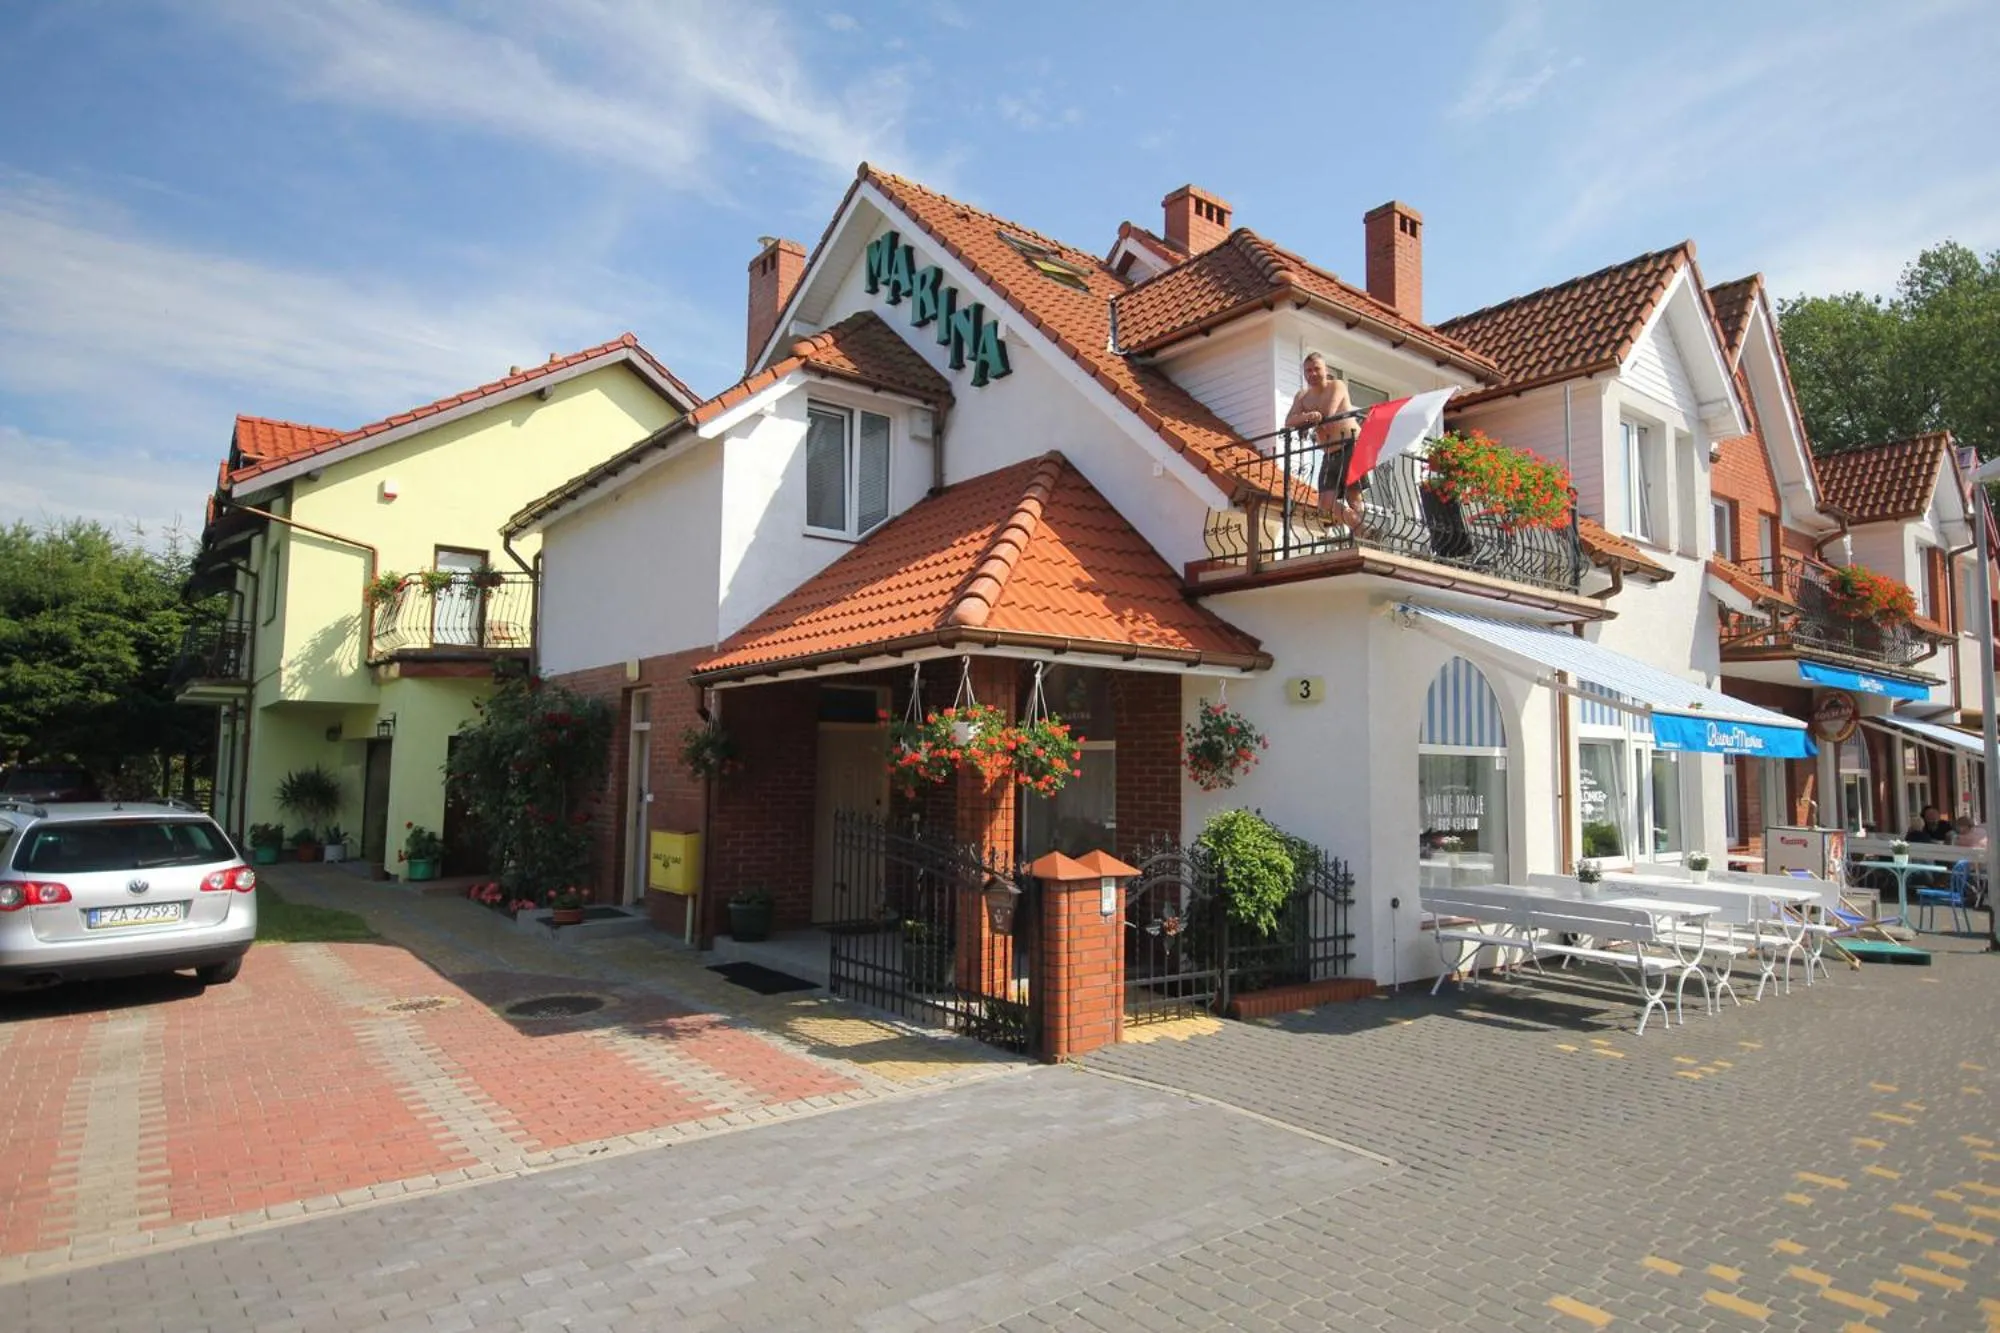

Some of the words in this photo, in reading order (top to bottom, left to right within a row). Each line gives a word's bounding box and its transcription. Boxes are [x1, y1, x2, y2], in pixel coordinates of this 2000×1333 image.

[865, 230, 1013, 387] MARINA
[1299, 679, 1311, 699] 3
[134, 904, 178, 919] 27593
